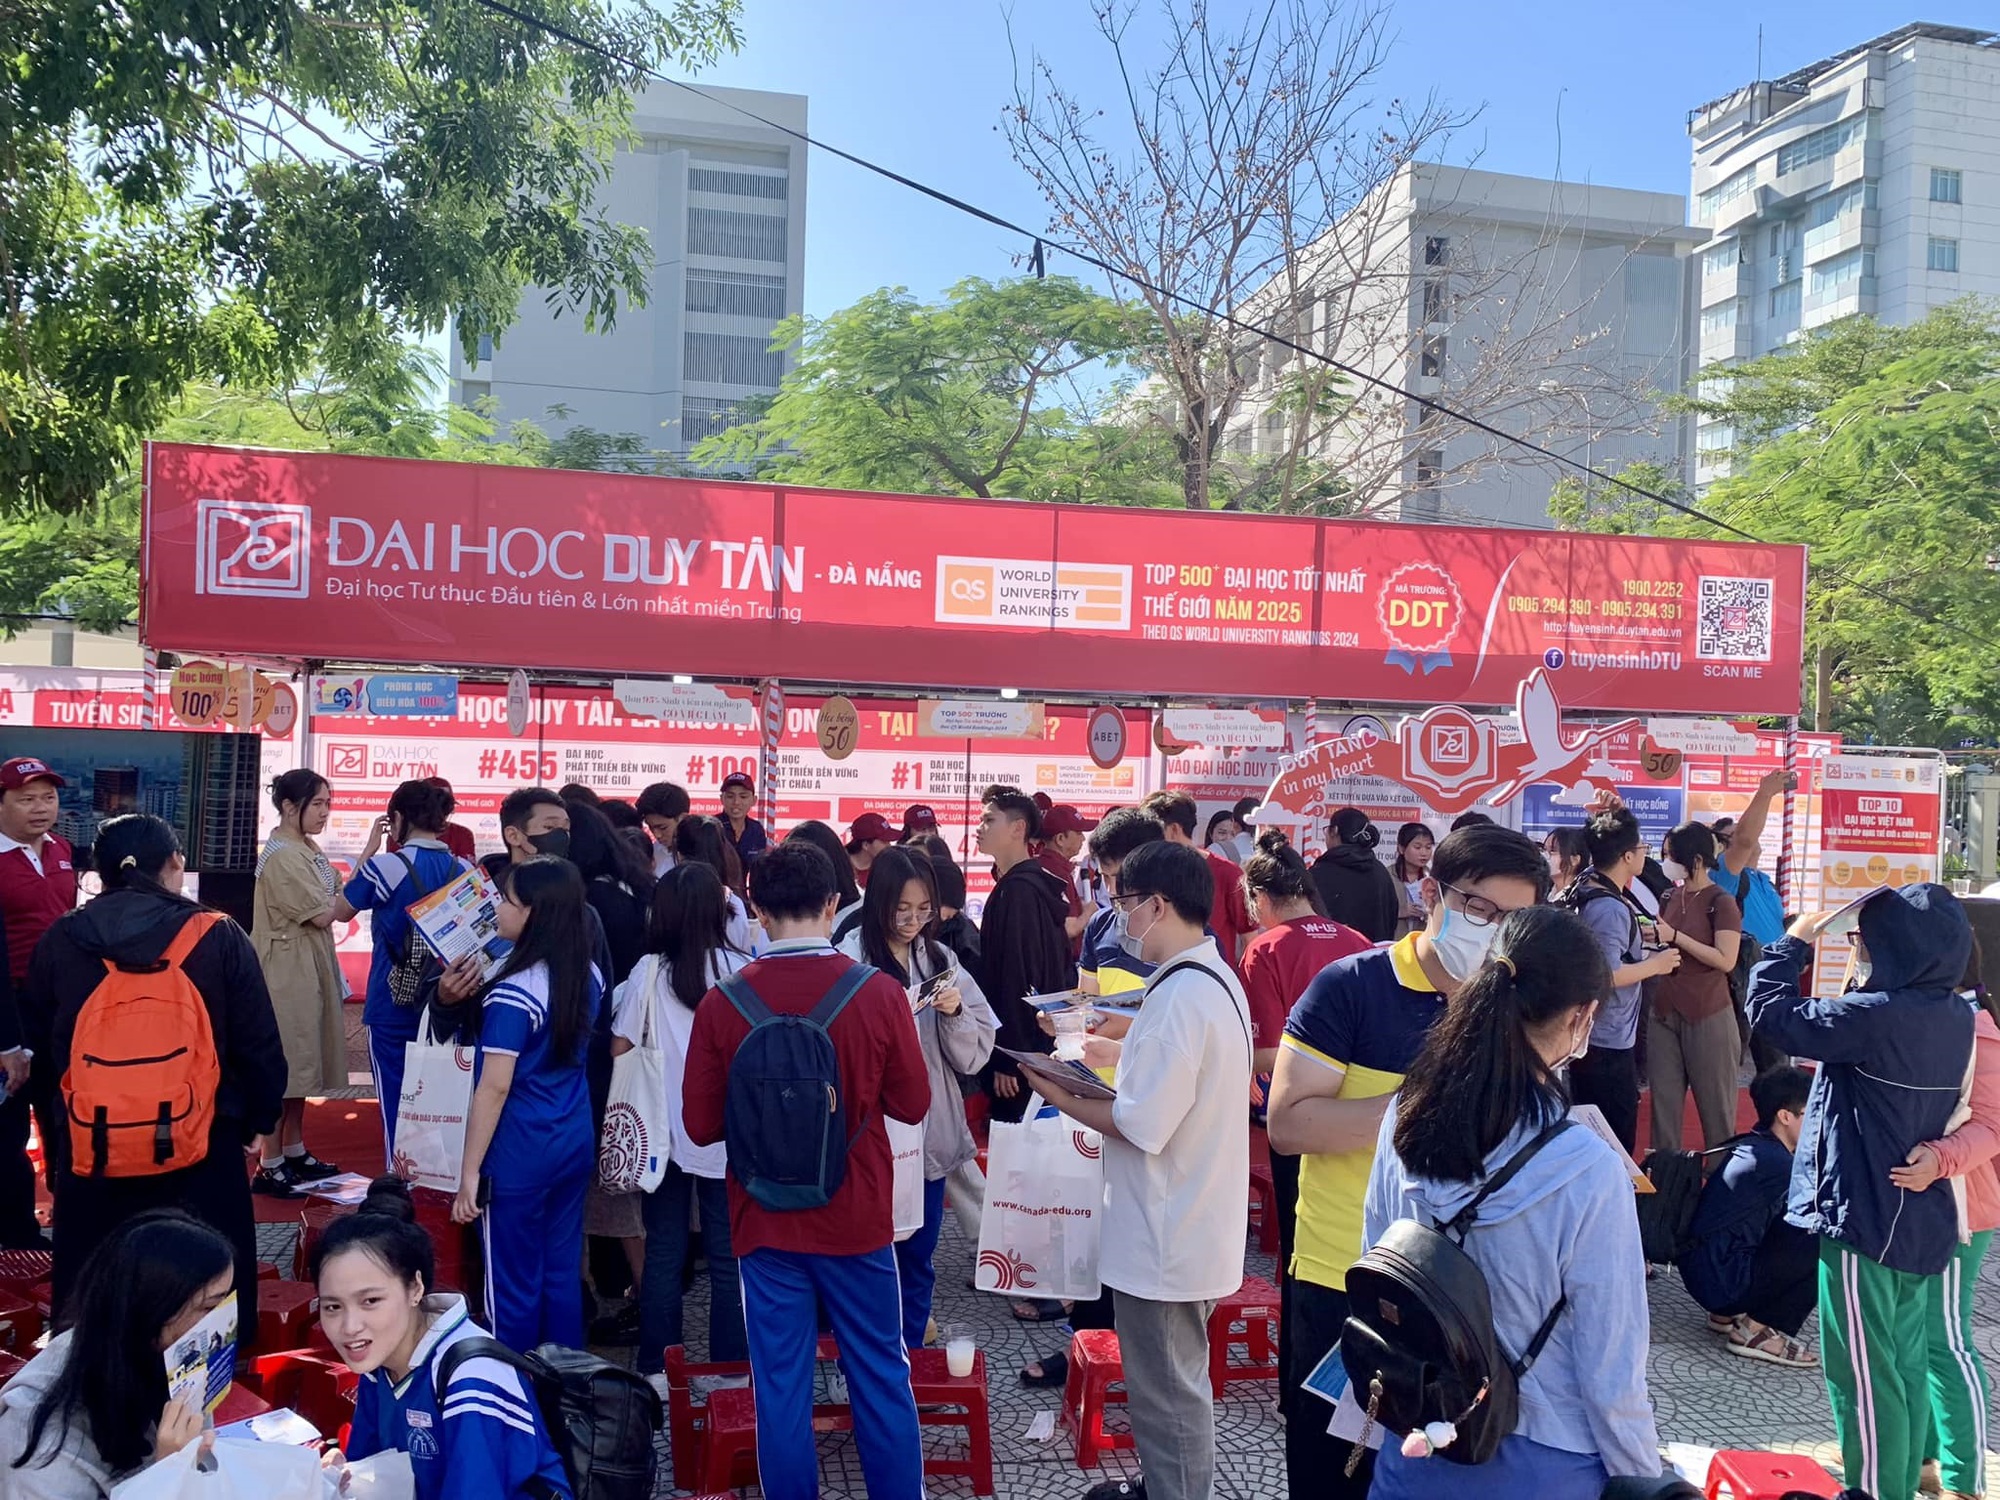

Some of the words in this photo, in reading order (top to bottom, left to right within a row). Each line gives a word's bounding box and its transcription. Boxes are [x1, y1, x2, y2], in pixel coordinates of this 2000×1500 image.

[326, 516, 434, 572] ĐẠI
[450, 523, 585, 580] HỌC
[602, 533, 702, 587] DUY
[711, 536, 805, 593] TÂN
[828, 561, 857, 585] ĐÀ
[865, 560, 922, 589] NẴNG
[1000, 569, 1051, 583] WORLD
[1144, 563, 1176, 586] TOP
[1224, 567, 1251, 591] ĐẠI
[1256, 568, 1288, 593] HỌC
[1293, 564, 1323, 592] TỐT
[1325, 567, 1367, 593] NHẤT
[950, 577, 986, 603] QS
[1000, 587, 1079, 601] UNIVERSITY
[1622, 580, 1684, 598] 1900.2252
[326, 577, 360, 600] Đại
[366, 578, 404, 601] học
[408, 581, 435, 601] Tư
[440, 583, 485, 606] thục
[491, 586, 532, 606] Đầu
[538, 588, 575, 607] tiên
[582, 591, 596, 609] &
[602, 590, 638, 612] Lớn
[644, 595, 688, 615] nhất
[694, 597, 742, 618] miền
[747, 601, 802, 624] Trung
[1142, 592, 1175, 618] THẾ
[1179, 594, 1211, 619] GIỚI
[1215, 596, 1252, 621] NĂM
[1257, 600, 1302, 623] 2025
[1508, 596, 1592, 616] 0905.294.390
[1602, 600, 1683, 620] 0905.294.391
[1000, 604, 1069, 618] RANKINGS
[1390, 599, 1449, 628] DDT
[1141, 624, 1168, 641] THEO
[1170, 625, 1184, 641] QS
[1185, 626, 1221, 643] WORLD
[1222, 627, 1281, 644] UNIVERSITY
[1282, 629, 1331, 646] RANKINGS
[1333, 632, 1360, 648] 2024
[1543, 620, 1682, 639] http://tuyensinh.duytan.edu.vn
[1571, 649, 1682, 672] tuyensinhDTU
[1703, 664, 1740, 679] SCAN
[1743, 665, 1763, 679] ME
[50, 695, 114, 725] TUYỂN
[273, 704, 291, 716] BET
[940, 710, 957, 718] TOP
[877, 711, 914, 742] TẠI
[1094, 731, 1119, 742] ABET
[823, 726, 850, 751] 50
[373, 745, 402, 761] ĐẠI
[403, 746, 439, 761] HỌC
[565, 749, 582, 760] ĐẠI
[584, 749, 604, 760] HỌC
[781, 754, 800, 765] HỌC
[1280, 749, 1320, 773] DUY
[1646, 752, 1674, 773] 50
[373, 762, 401, 778] DUY
[407, 761, 438, 778] TÂN
[478, 749, 557, 781] #455
[565, 760, 590, 772] PHÁT
[1167, 757, 1191, 774] VÀO
[1193, 760, 1214, 778] ĐẠI
[1216, 761, 1240, 779] HỌC
[1243, 762, 1267, 778] DUY
[1282, 779, 1299, 796] in
[1302, 772, 1328, 790] my
[1329, 752, 1375, 779] heart
[788, 778, 813, 790] CHÂU
[891, 761, 923, 790] #1
[929, 772, 952, 782] PHÁT
[1635, 799, 1649, 810] HỌC
[1861, 800, 1881, 811] TOP
[1886, 801, 1898, 812] 10
[1860, 816, 1876, 828] HỌC
[1877, 815, 1895, 829] VIỆT
[1896, 817, 1914, 828] NAM
[992, 1199, 1092, 1220] www.canada-edu.org
